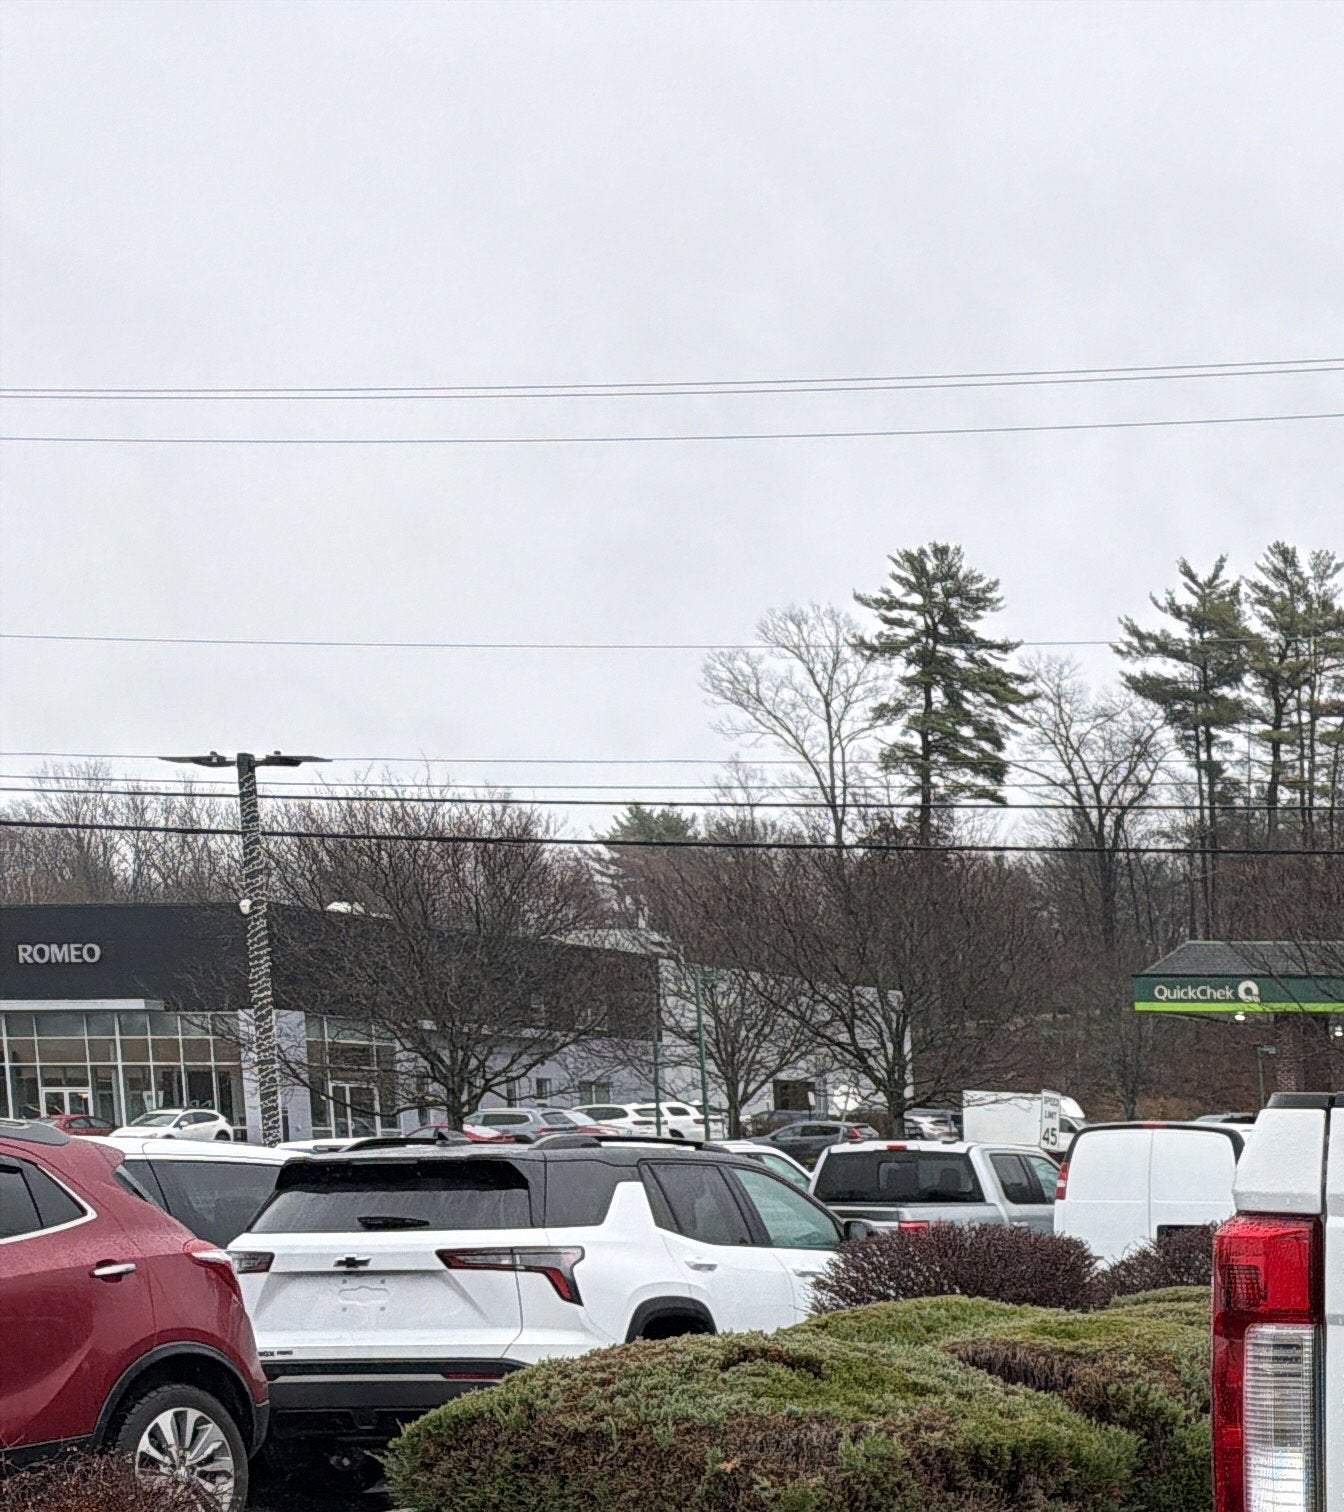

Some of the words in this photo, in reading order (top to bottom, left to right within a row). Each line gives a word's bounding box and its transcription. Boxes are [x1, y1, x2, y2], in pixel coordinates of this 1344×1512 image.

[17, 942, 101, 964] ROMEO
[1153, 984, 1235, 1003] QuickChek
[1042, 1127, 1058, 1147] 45
